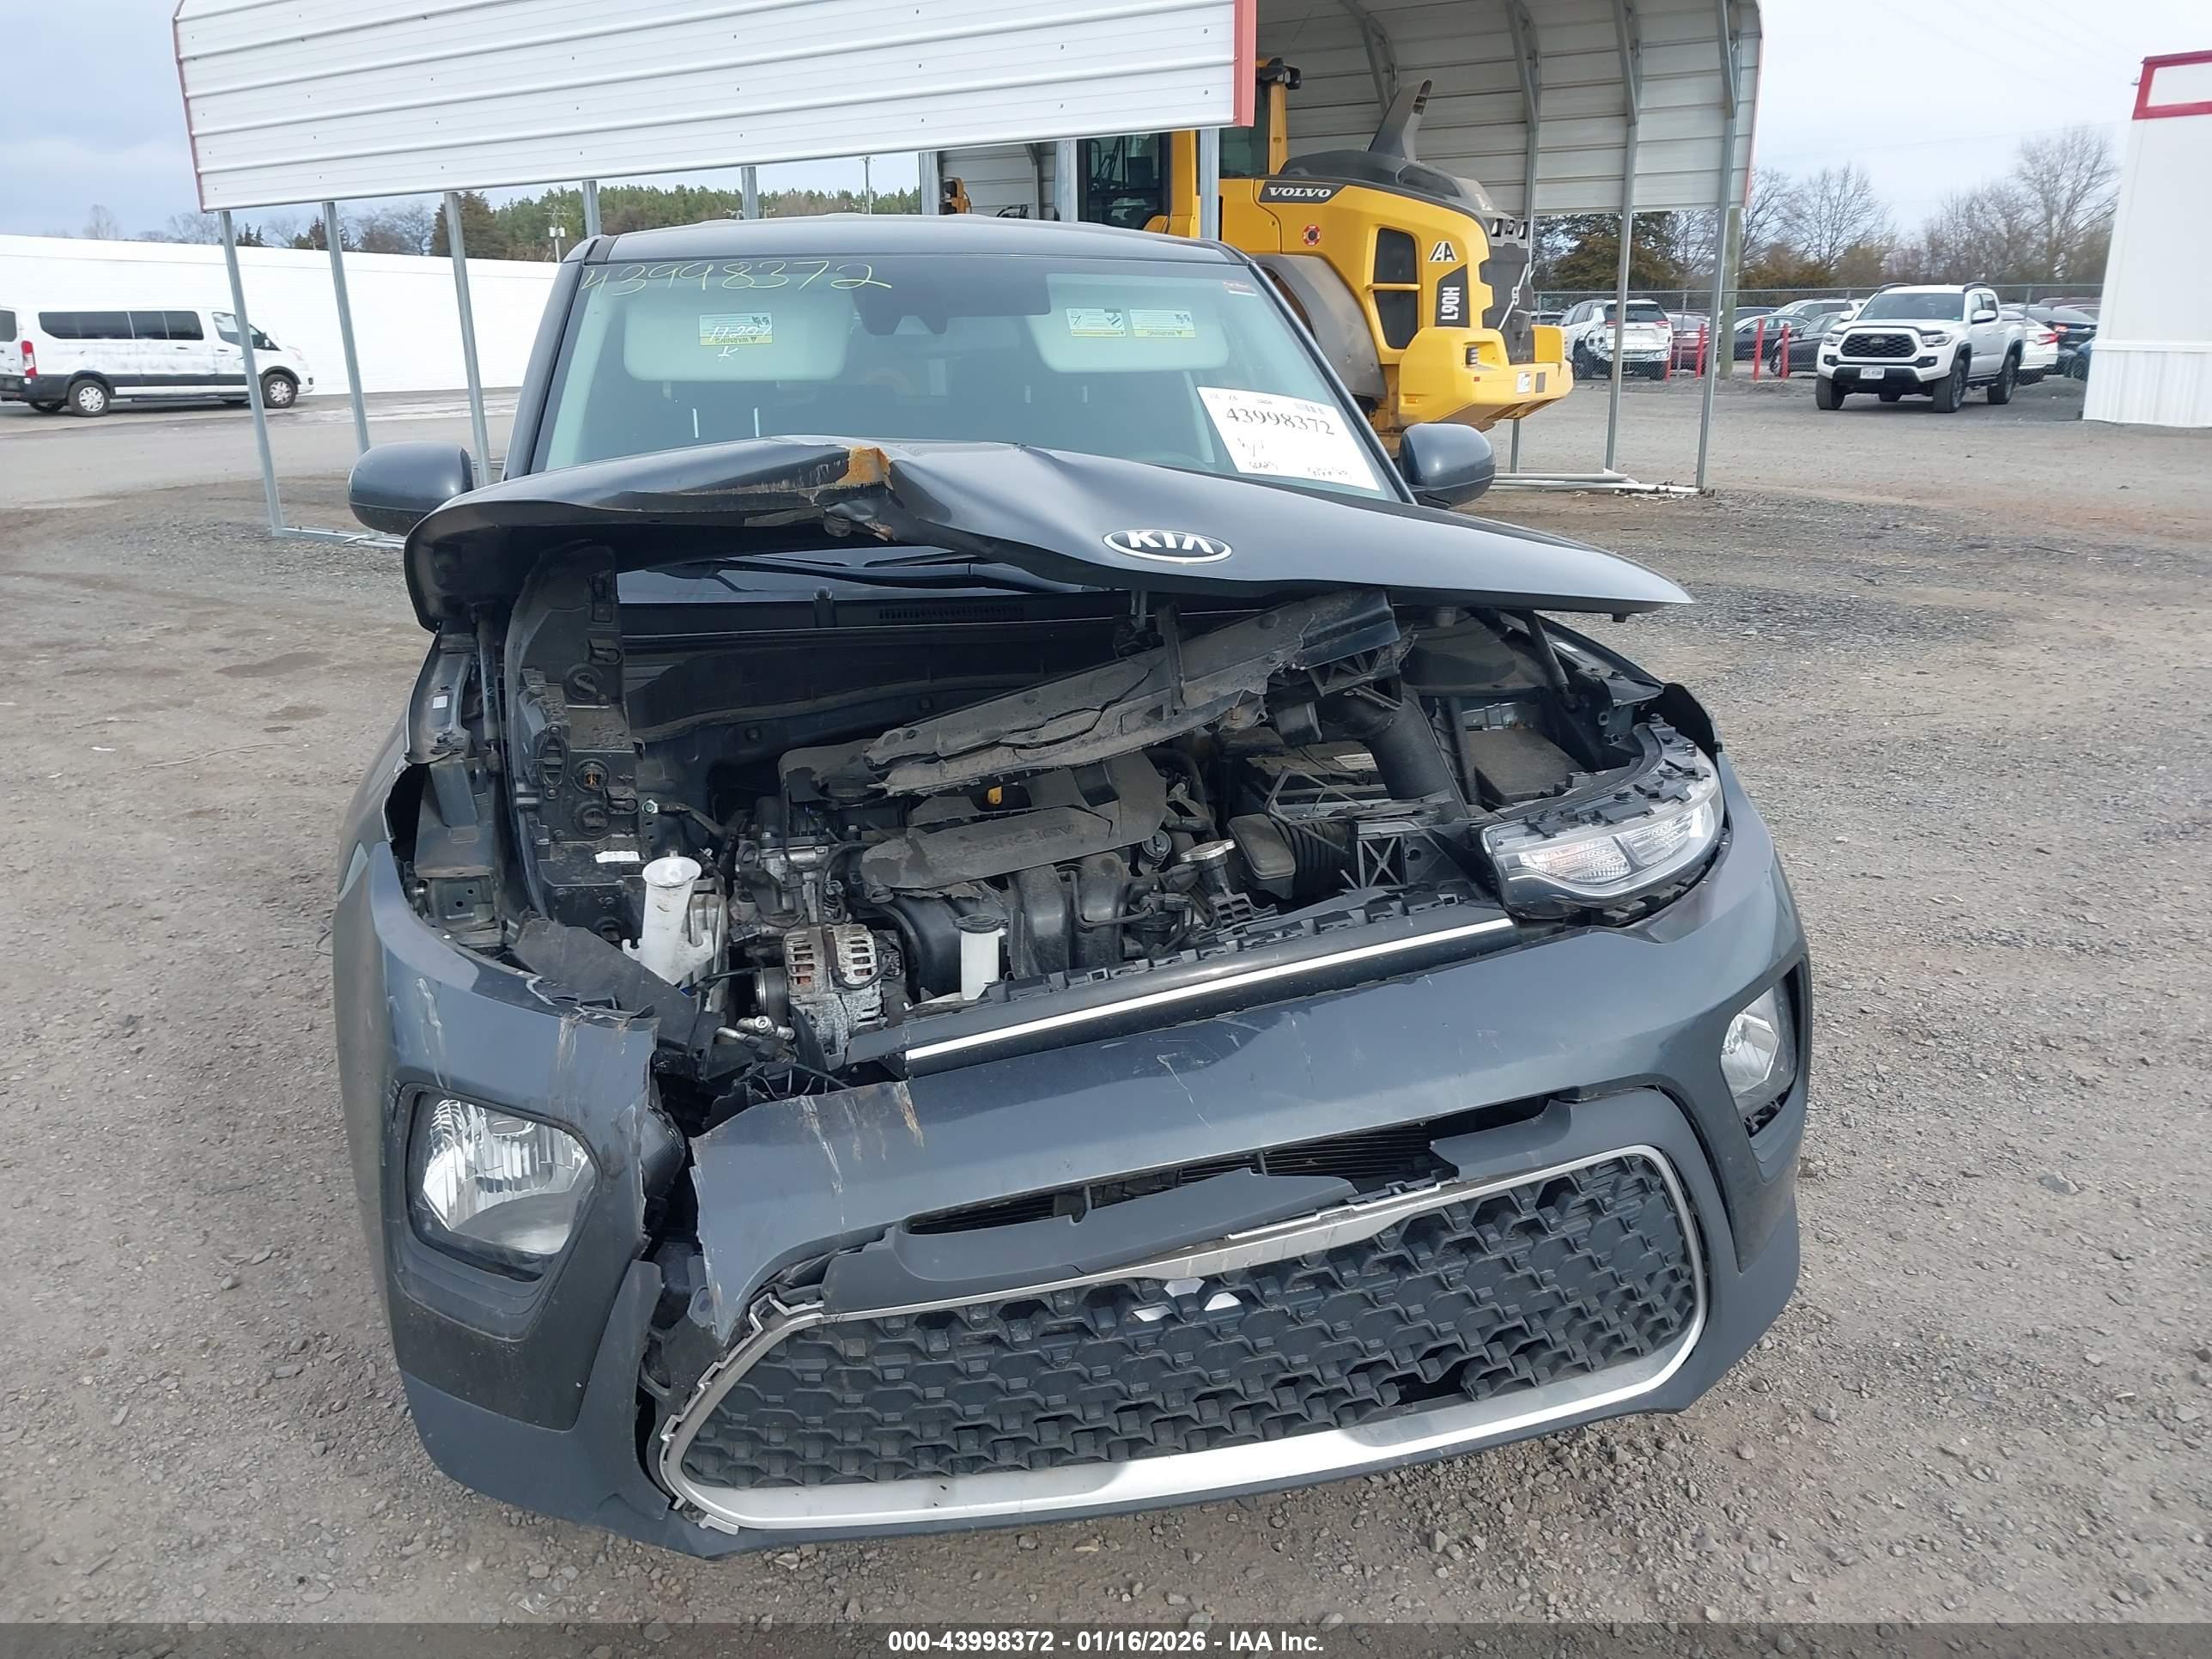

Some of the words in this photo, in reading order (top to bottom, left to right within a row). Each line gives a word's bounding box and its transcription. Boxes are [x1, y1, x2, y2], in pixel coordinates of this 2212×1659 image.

[1268, 186, 1332, 198] VOLVO
[581, 260, 892, 296] 43998372
[1441, 286, 1461, 320] L90H
[1226, 407, 1335, 436] 43998372
[1126, 531, 1215, 555] KIA
